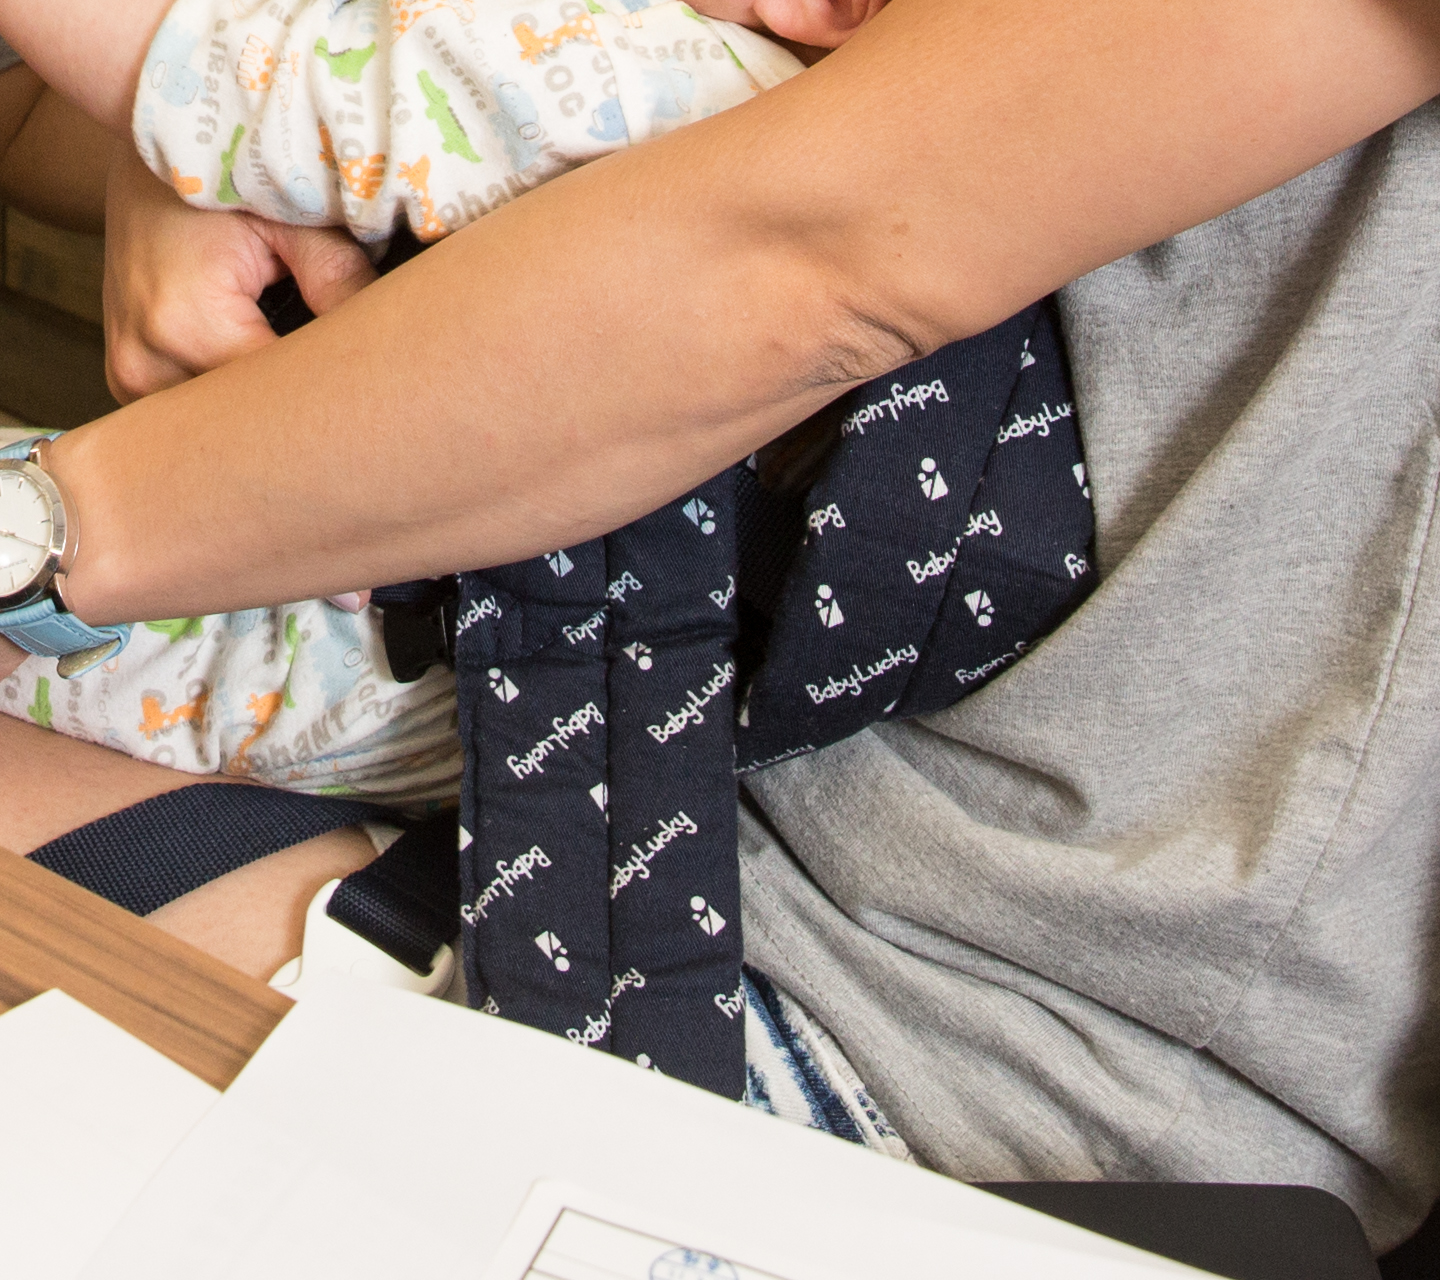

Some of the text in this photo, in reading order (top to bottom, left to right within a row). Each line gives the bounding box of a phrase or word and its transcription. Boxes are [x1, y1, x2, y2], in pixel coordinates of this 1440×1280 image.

[645, 655, 736, 744] BabyLuck
[805, 643, 920, 706] BabyLucky
[506, 700, 606, 781] BabyLucky
[460, 844, 553, 927] BabyLucky
